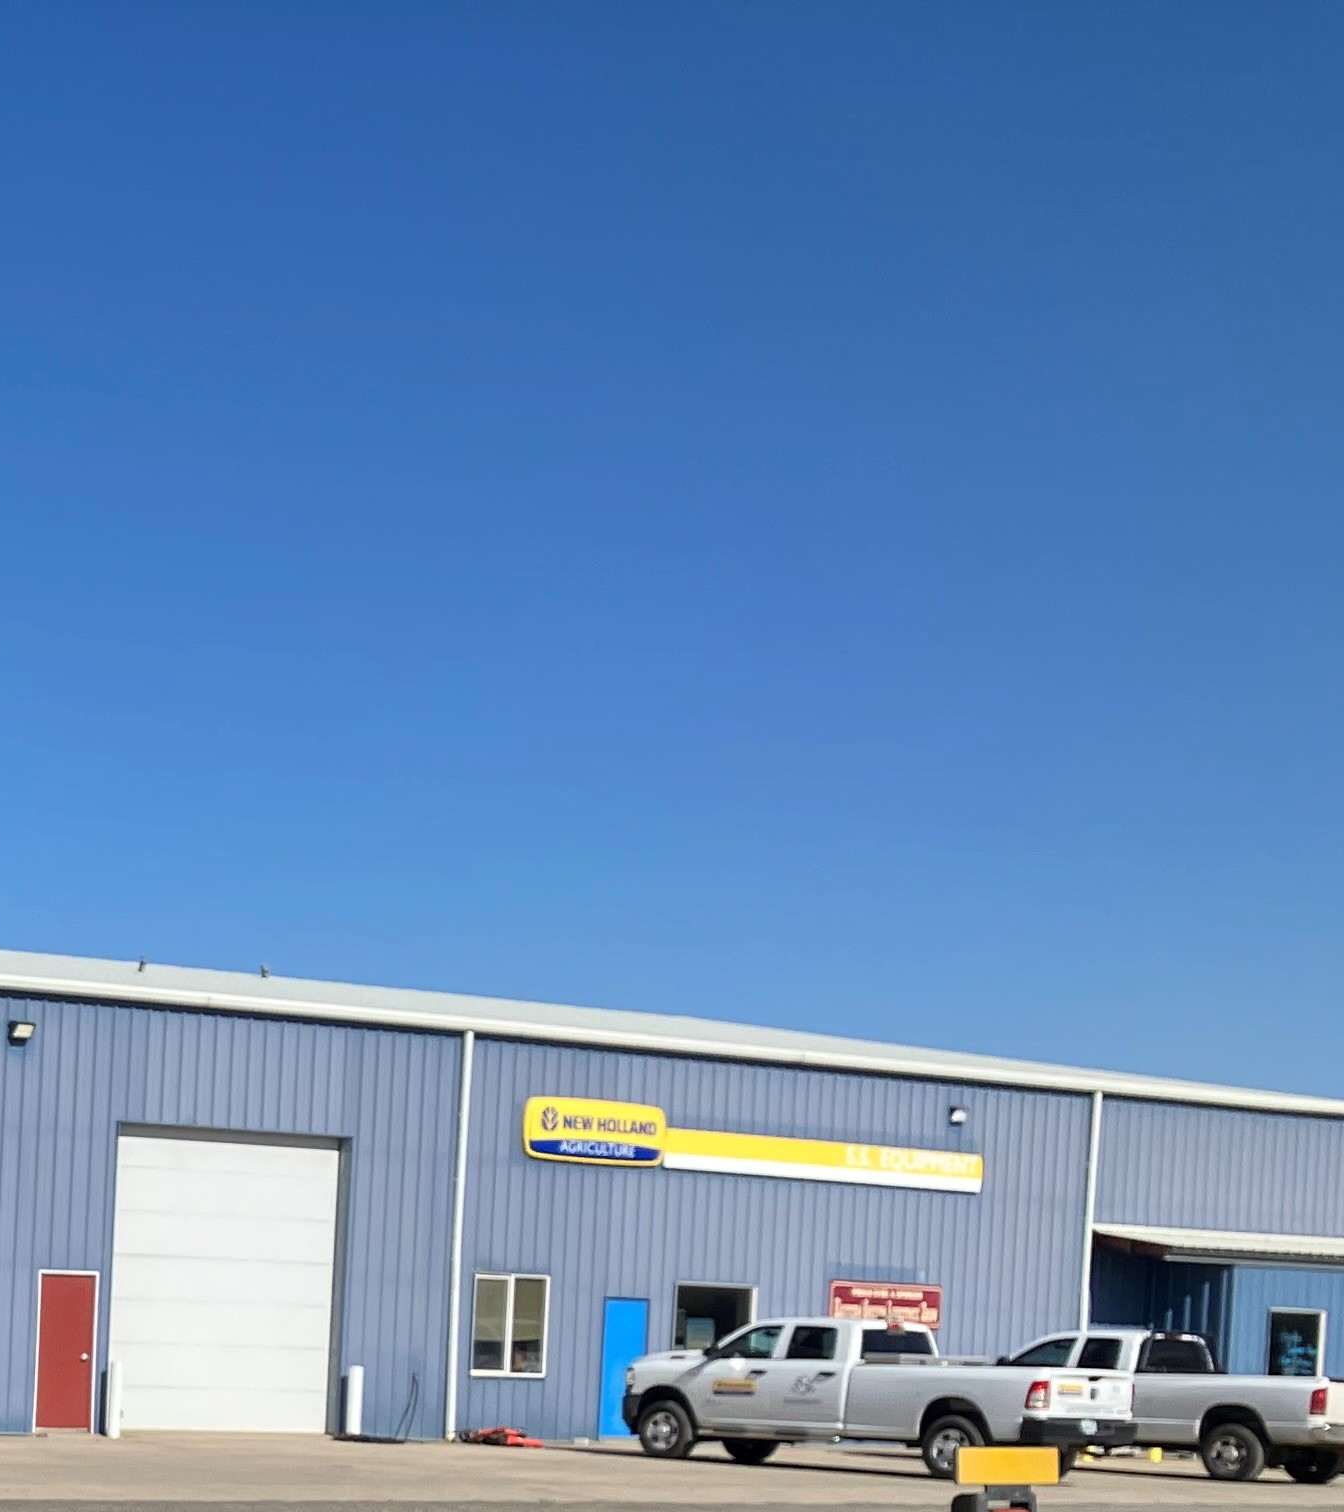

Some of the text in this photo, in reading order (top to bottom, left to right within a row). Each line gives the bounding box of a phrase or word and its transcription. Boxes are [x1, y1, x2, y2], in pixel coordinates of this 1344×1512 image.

[562, 1115, 657, 1136] NEW HOLLAND
[559, 1140, 637, 1159] AGRICULTURE
